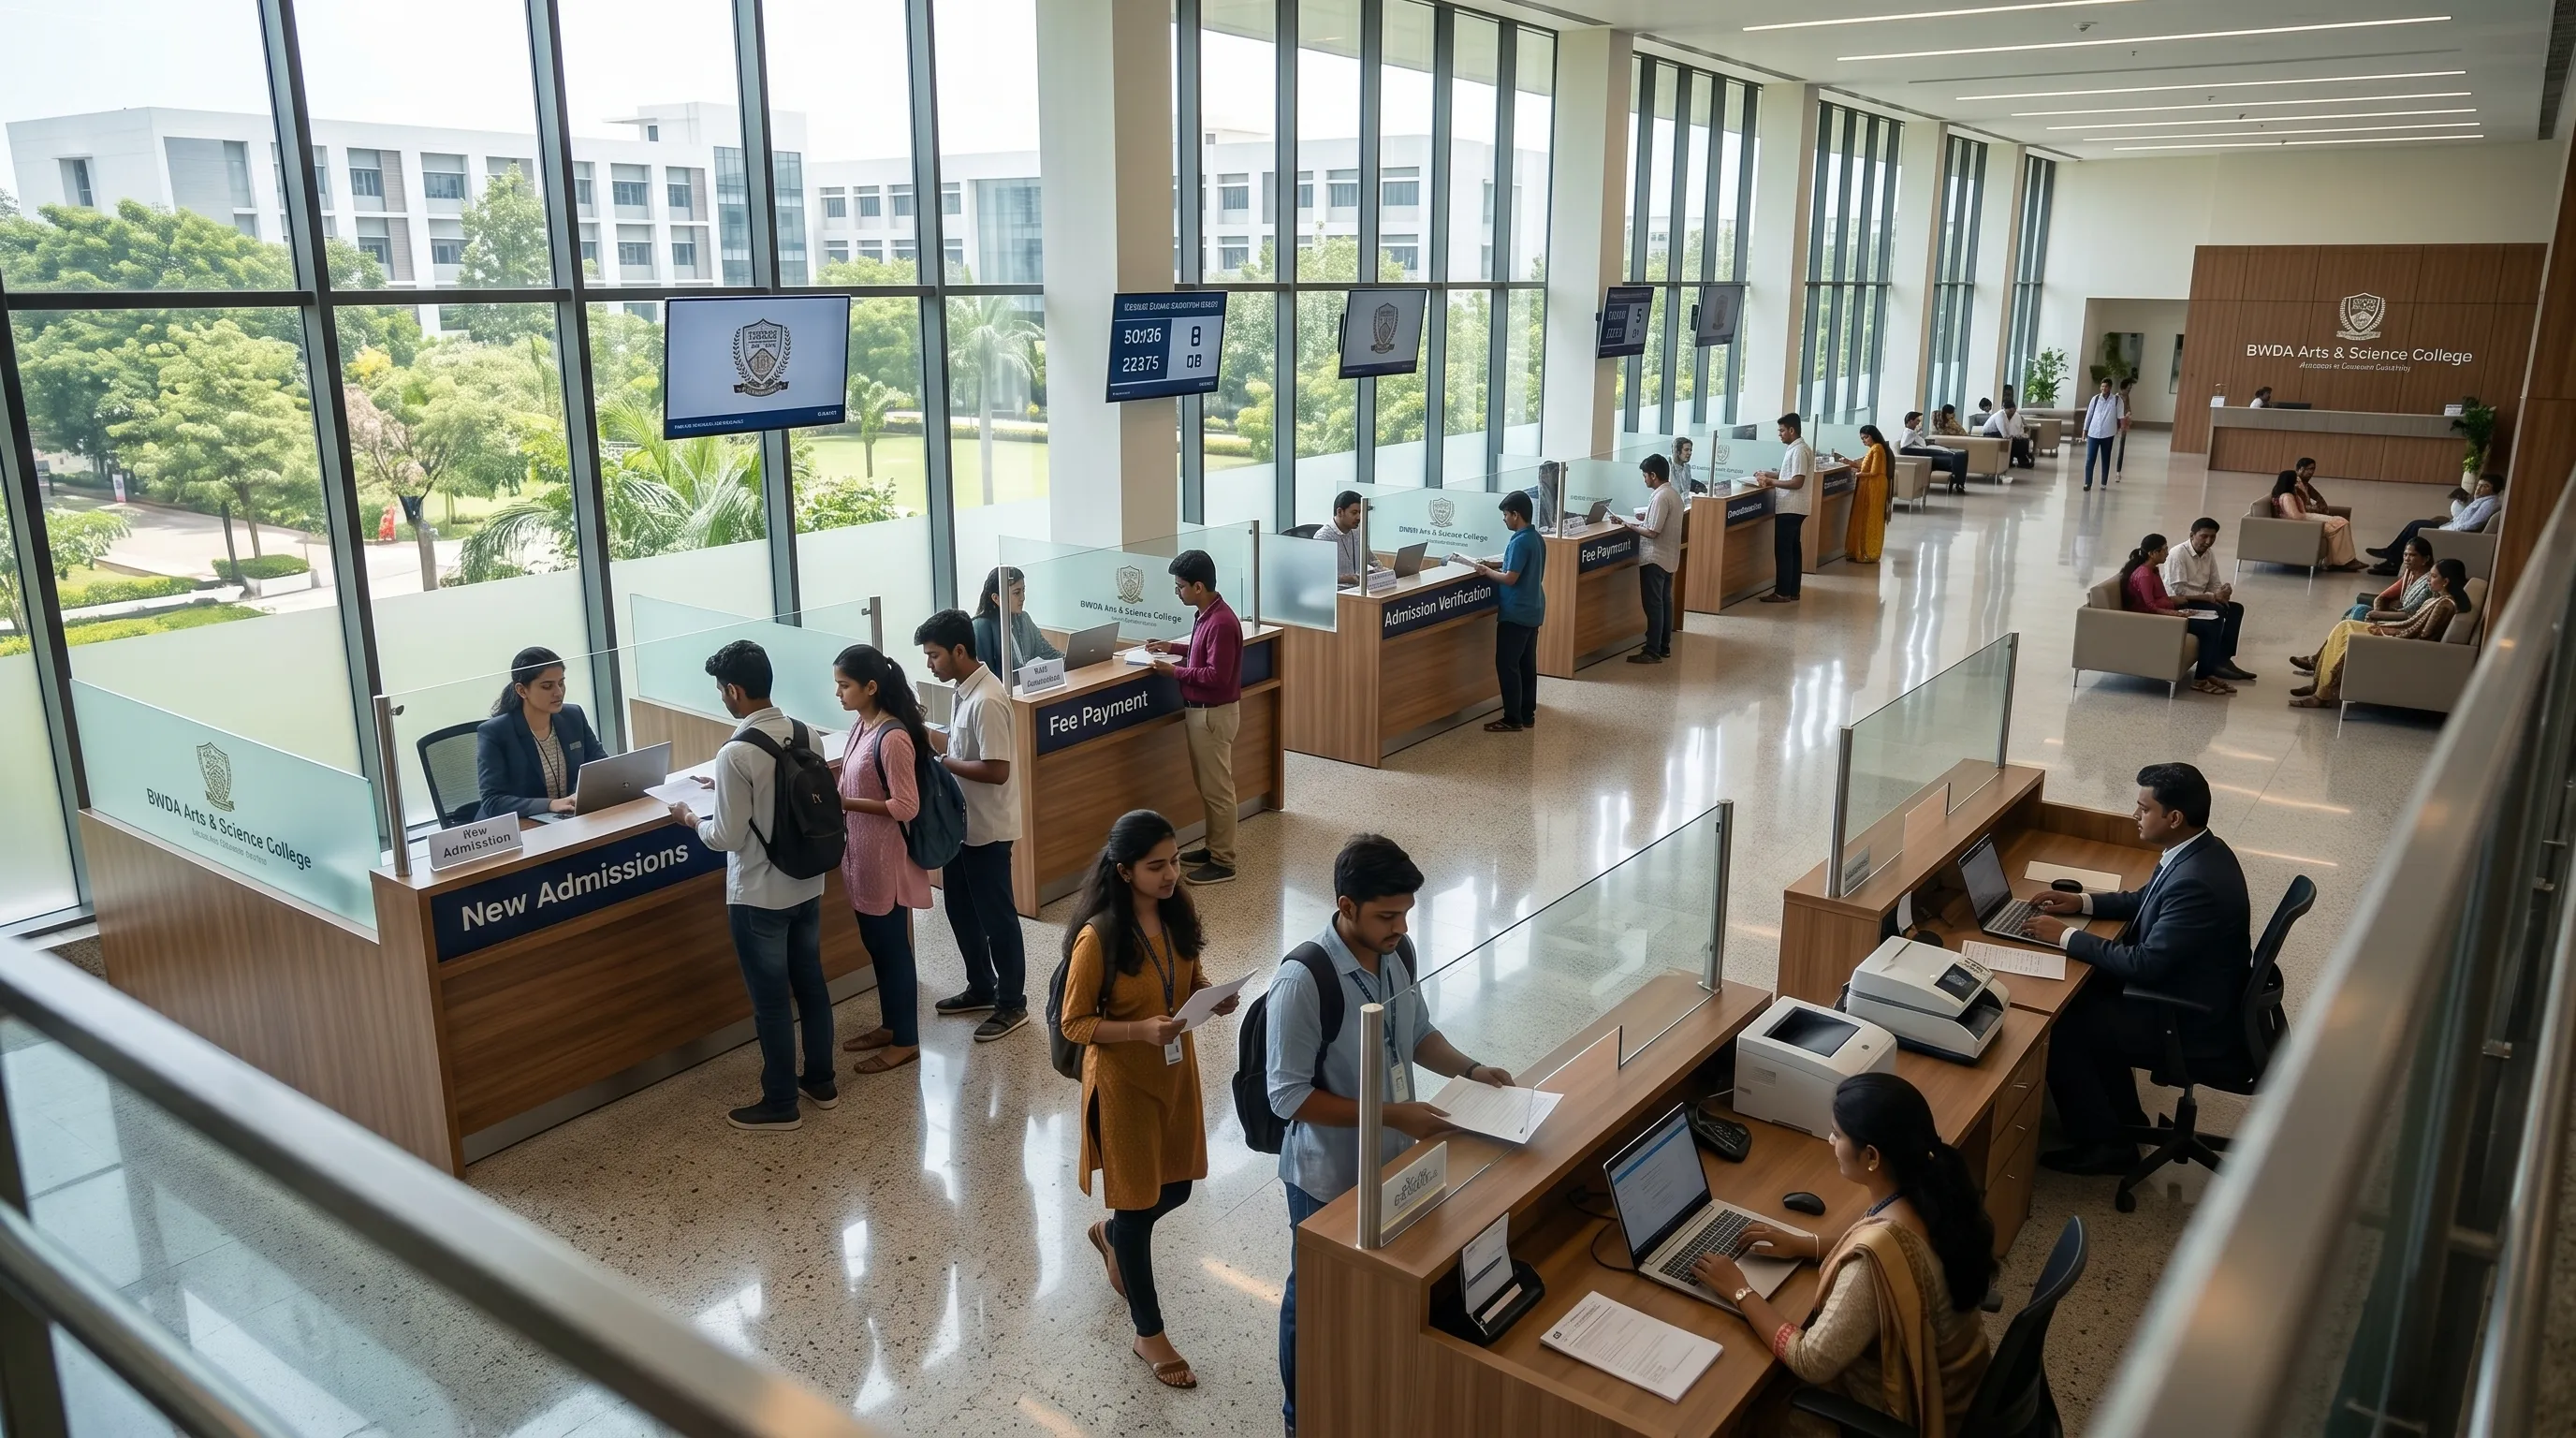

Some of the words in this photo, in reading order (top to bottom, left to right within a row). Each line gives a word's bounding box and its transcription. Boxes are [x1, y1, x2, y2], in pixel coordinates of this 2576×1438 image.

[2247, 344, 2294, 358] BWDA
[2297, 345, 2329, 359] Arts
[2334, 346, 2345, 360] &
[2349, 346, 2408, 361] Science
[2412, 348, 2473, 366] College
[1581, 550, 1596, 563] Fee
[1385, 601, 1437, 627] Admission
[1439, 585, 1491, 610] Verification
[1049, 713, 1077, 737] Fee
[1082, 690, 1149, 726] Payment
[146, 787, 182, 816] BWDA
[183, 804, 206, 826] Arts
[209, 813, 217, 830] &
[219, 817, 263, 849] Science
[267, 836, 312, 871] College
[443, 831, 511, 858] Admisstion
[461, 893, 527, 931] New
[536, 844, 689, 909] Admissions
